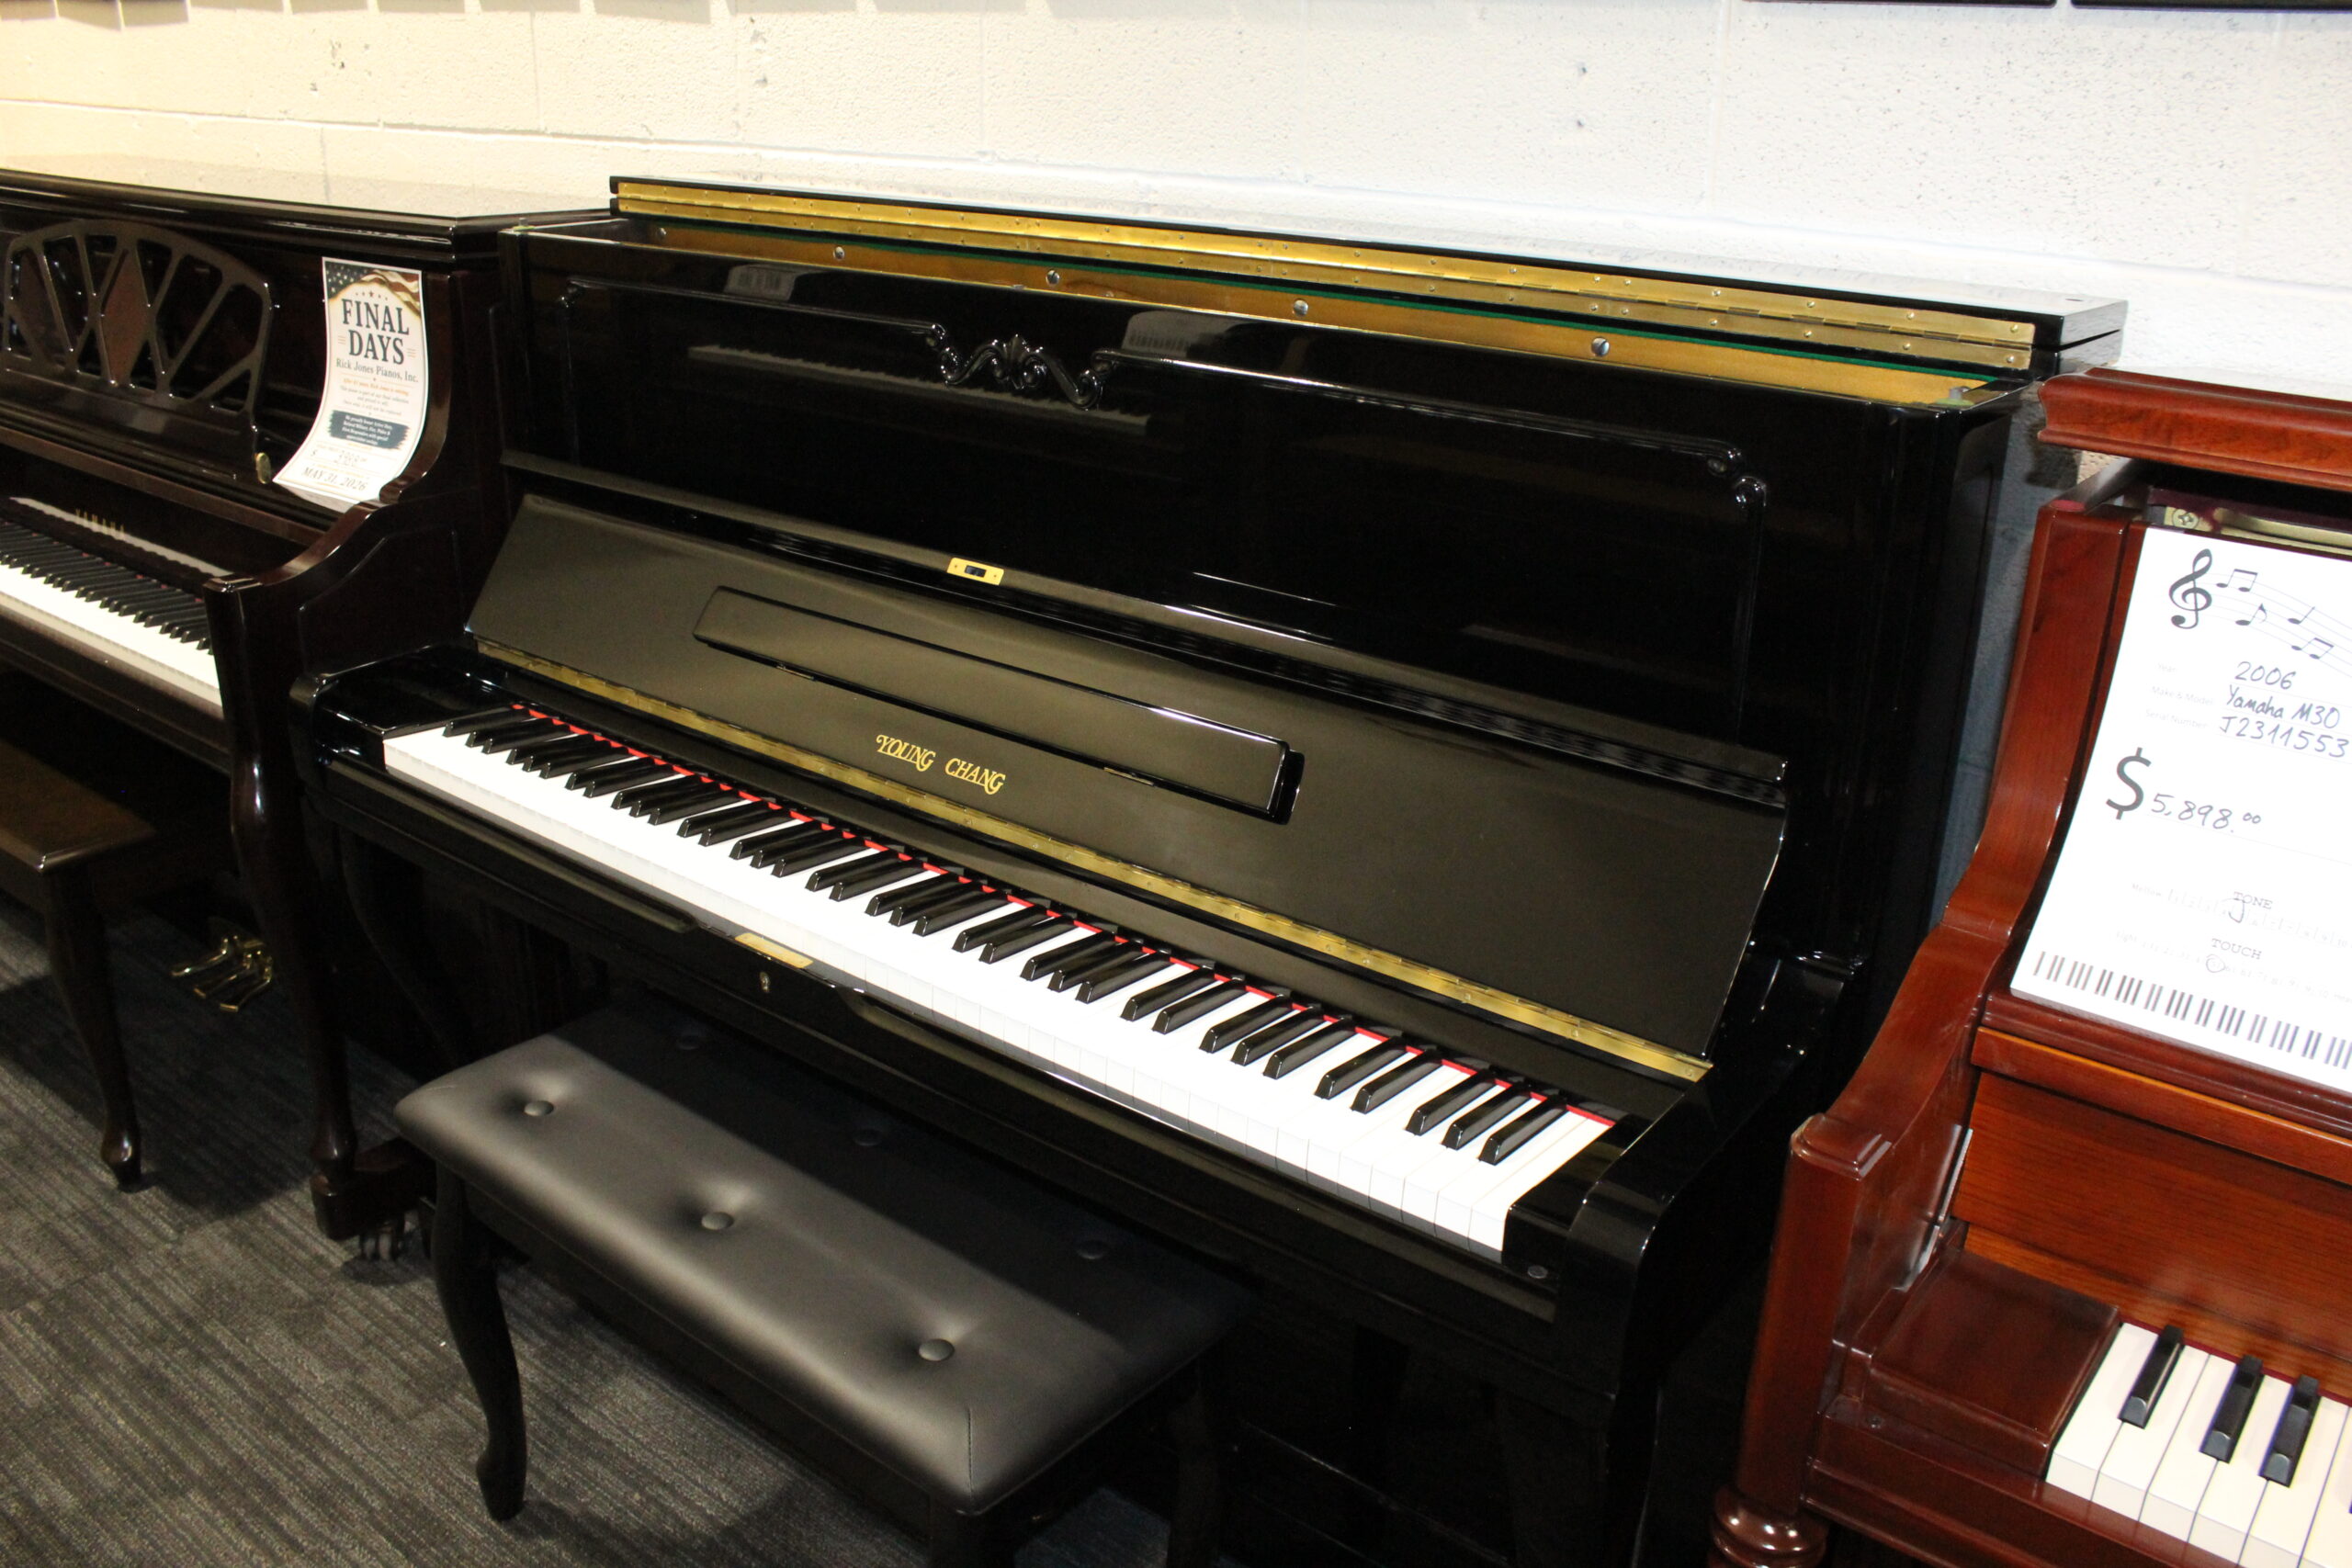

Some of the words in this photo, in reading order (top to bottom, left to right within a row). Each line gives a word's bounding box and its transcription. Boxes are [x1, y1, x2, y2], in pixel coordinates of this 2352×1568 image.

[342, 299, 410, 335] FINAL
[348, 330, 404, 365] DAYS
[336, 358, 352, 369] Rick
[354, 361, 374, 374] Jones
[376, 366, 402, 380] Pianos,
[404, 371, 419, 383] Inc.
[301, 467, 326, 480] MAY
[339, 477, 368, 491] 2026
[2234, 660, 2296, 690] 2006
[2226, 684, 2284, 718] Yamaha
[2291, 703, 2340, 728] M30
[2219, 716, 2349, 758] J2311553
[876, 734, 936, 773] YOUNG
[944, 758, 1006, 795] CHANG
[2106, 747, 2152, 820] $
[2233, 891, 2274, 910] TONE
[2211, 938, 2263, 961] TOUCH
